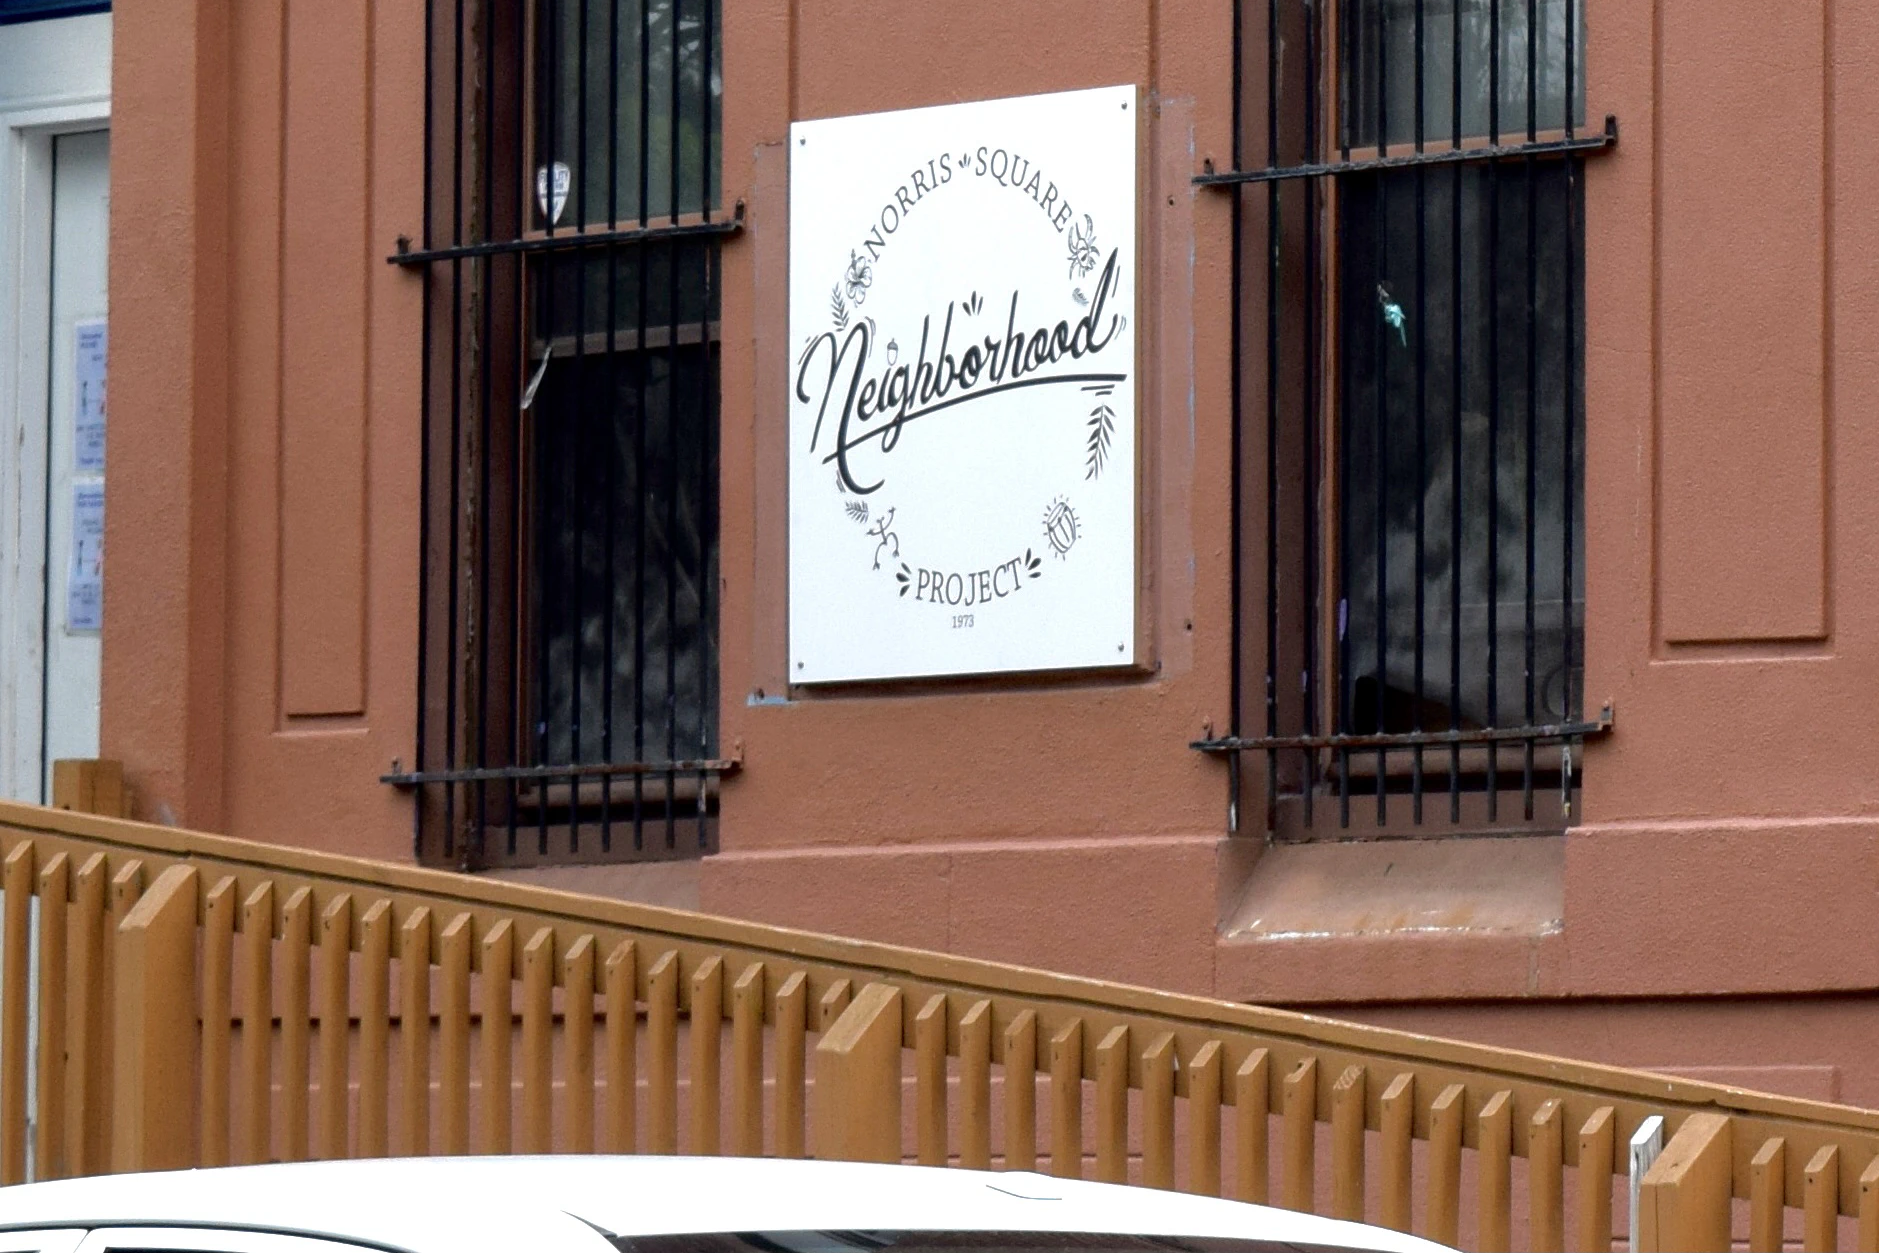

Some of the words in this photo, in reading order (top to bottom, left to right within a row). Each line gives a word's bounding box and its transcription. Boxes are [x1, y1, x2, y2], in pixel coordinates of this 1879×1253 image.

[863, 152, 952, 263] NORRIS
[975, 146, 1073, 234] SQUARE
[796, 246, 1119, 495] Neighborhood
[915, 556, 1022, 607] PROJECT
[951, 614, 975, 629] 1973
